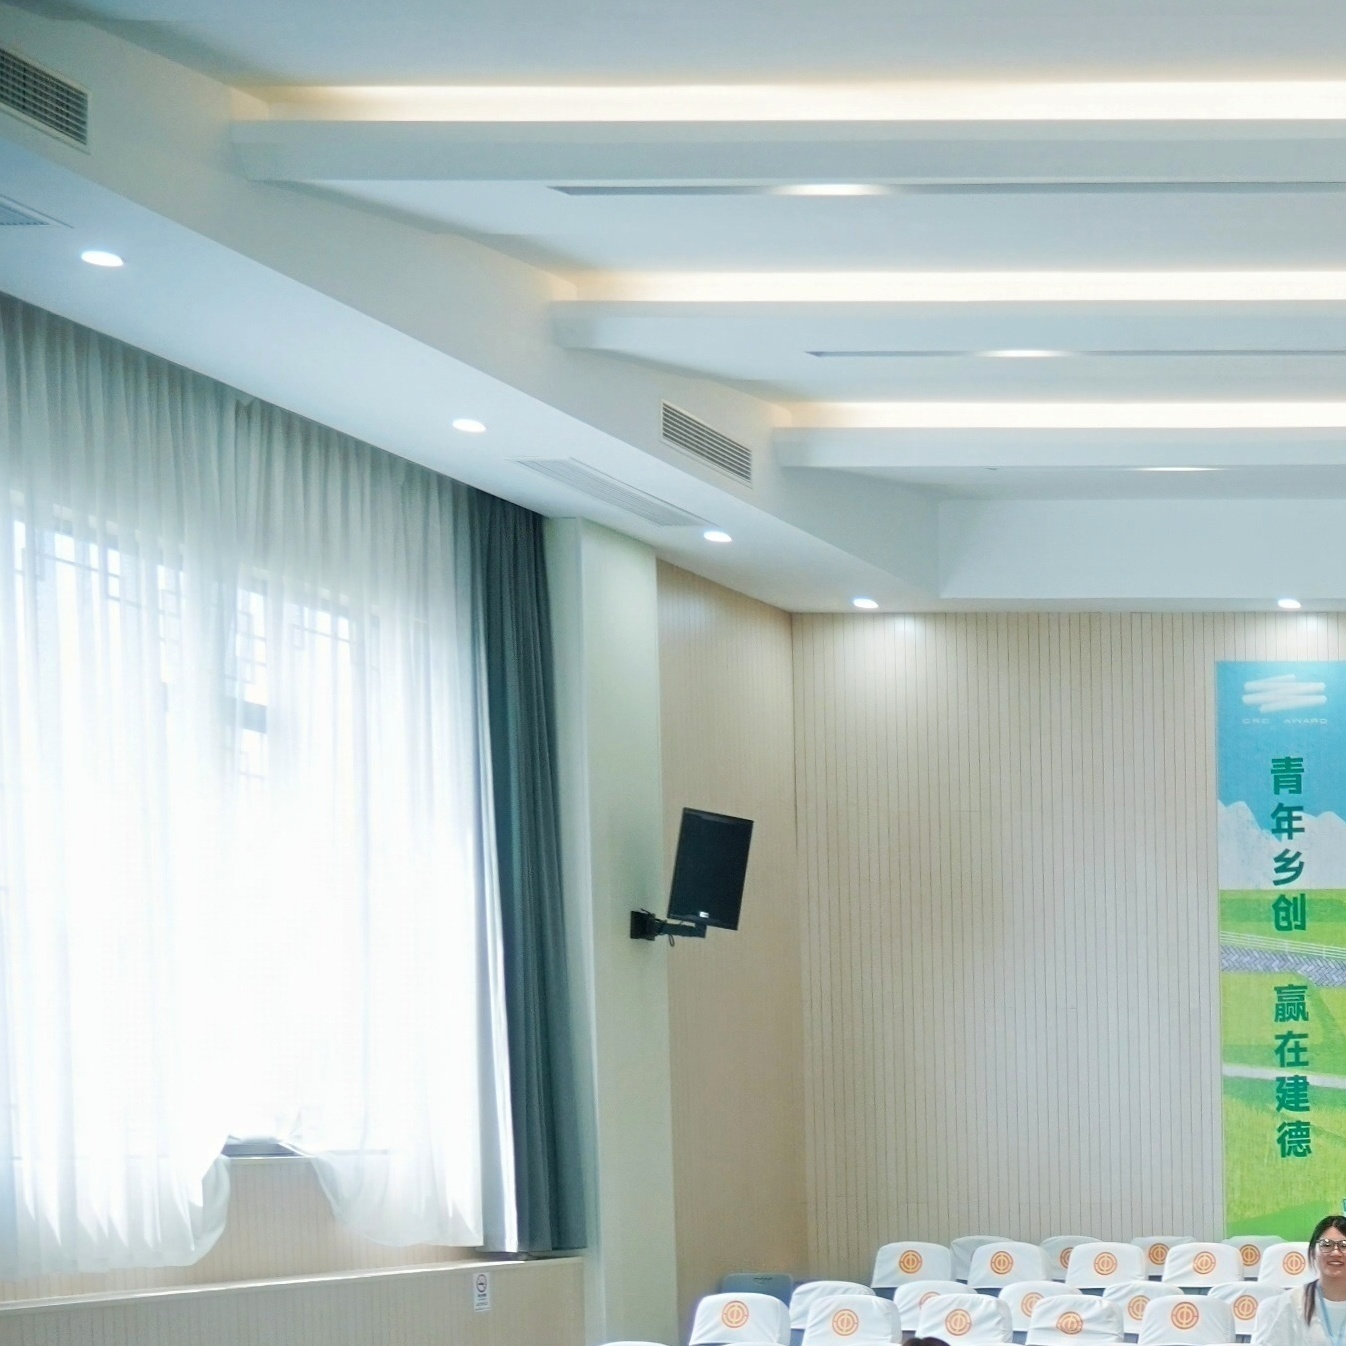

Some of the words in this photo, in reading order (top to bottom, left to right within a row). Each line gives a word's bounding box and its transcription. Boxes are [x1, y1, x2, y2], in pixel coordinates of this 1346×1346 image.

[1270, 756, 1307, 932] 青年乡创
[1273, 984, 1312, 1159] 赢在建德
